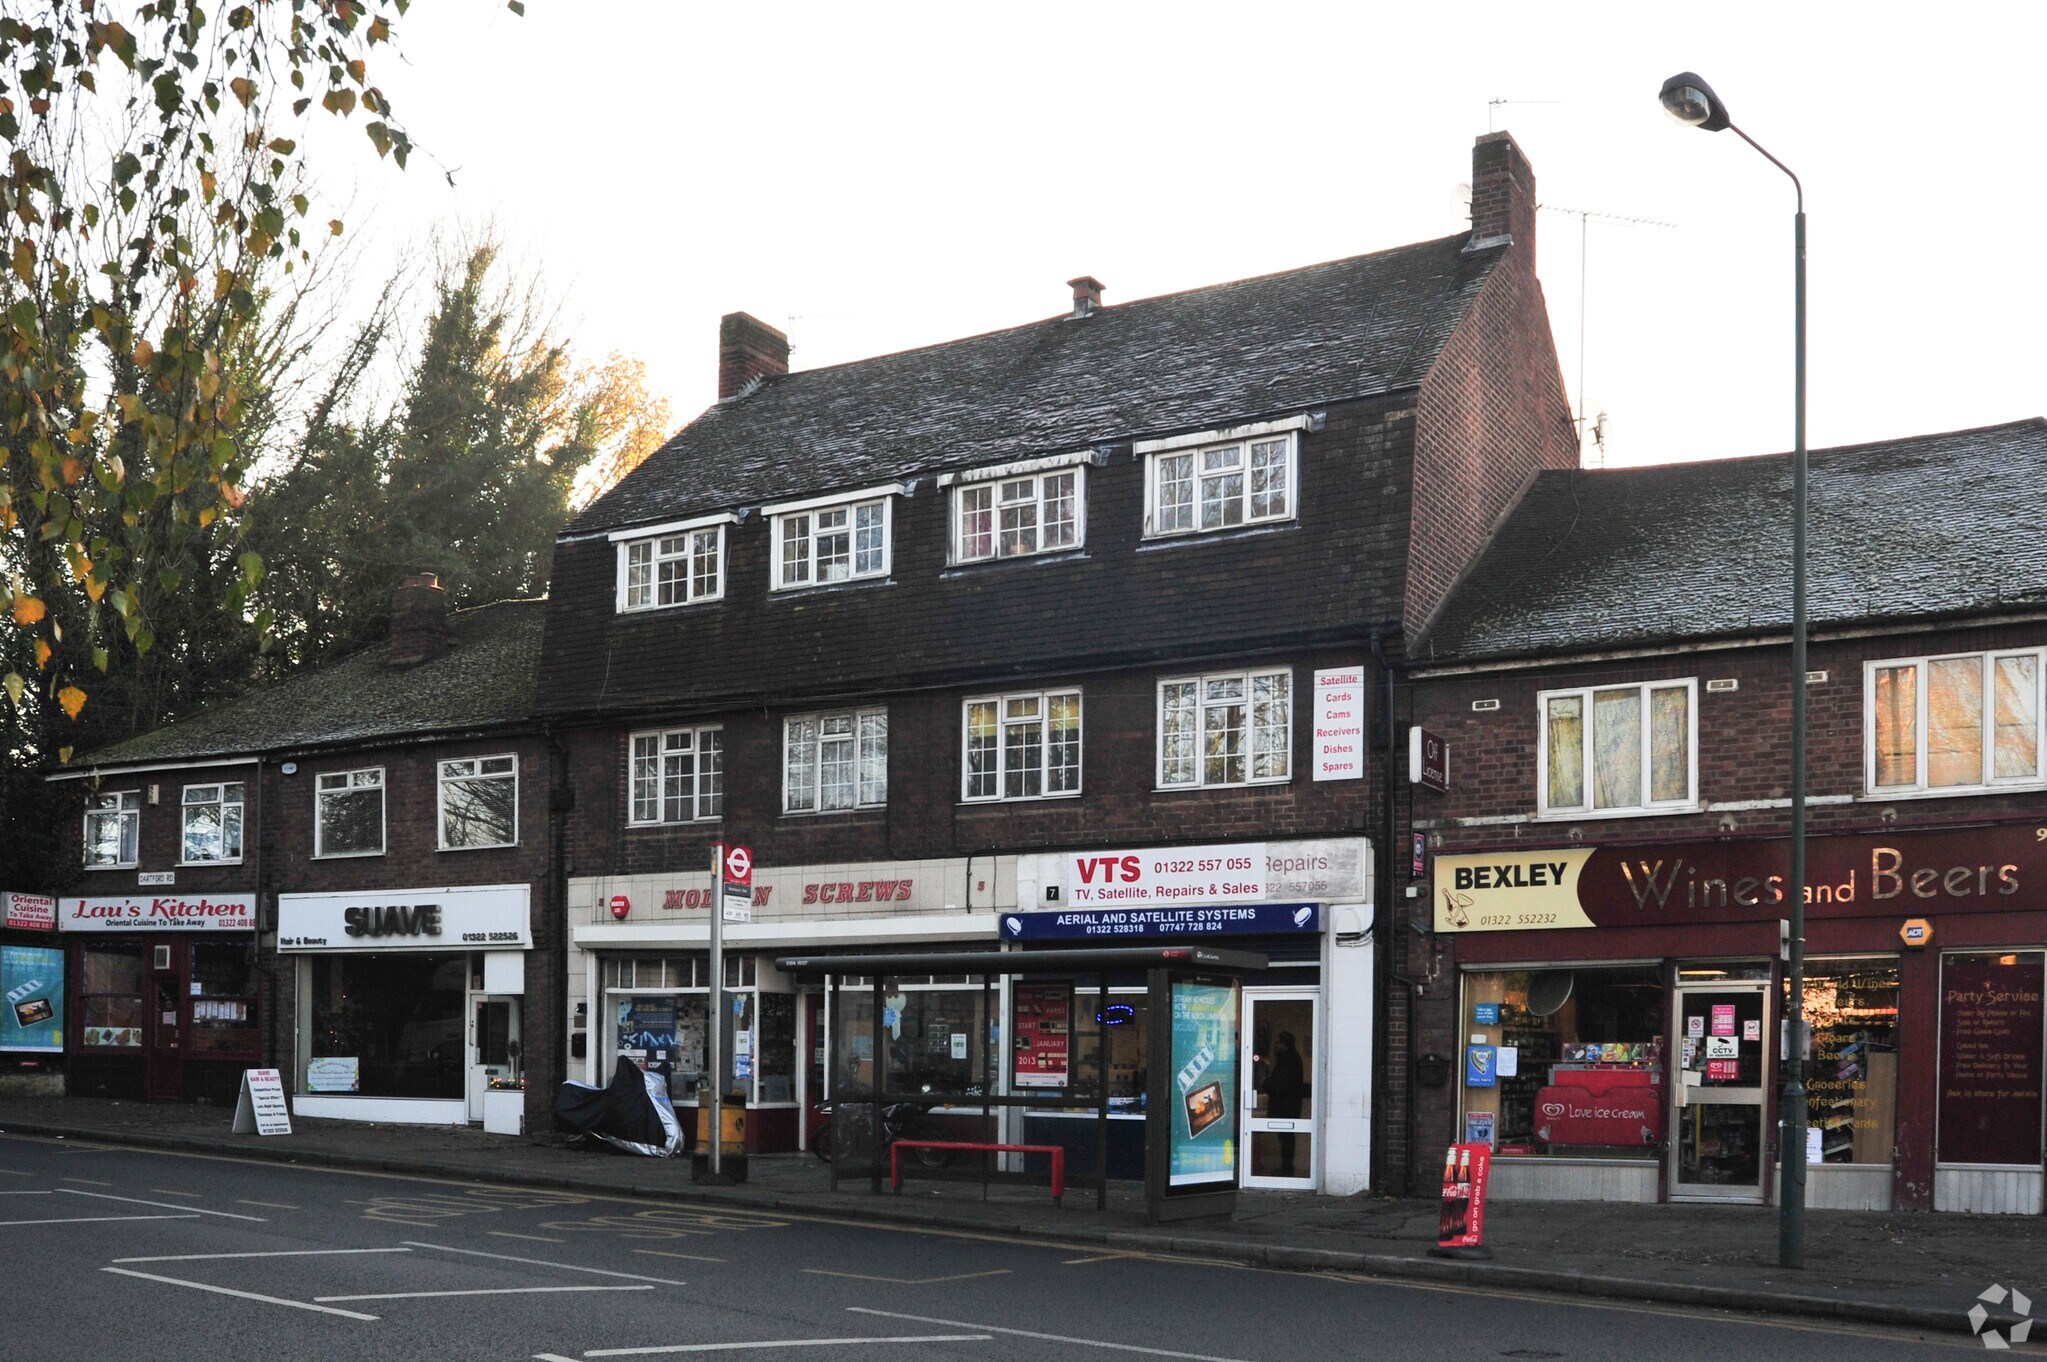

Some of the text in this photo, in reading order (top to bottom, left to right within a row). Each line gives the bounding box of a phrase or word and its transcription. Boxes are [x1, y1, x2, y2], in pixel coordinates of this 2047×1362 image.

[1320, 675, 1358, 686] Satellite
[1326, 692, 1352, 702] Cards
[1326, 711, 1351, 720] Cams
[1316, 727, 1361, 737] Receivers
[1323, 745, 1353, 754] Dishes
[1427, 740, 1438, 761] Off
[1322, 762, 1353, 773] Spares
[1077, 856, 1251, 883] VTS 01322 557 055
[1455, 862, 1568, 890] BEXLEY
[1620, 847, 2018, 910] Wines and Beers
[803, 879, 913, 905] SCREWS
[1075, 882, 1259, 901] TV, Satellite, Repairs & Sales
[1289, 881, 1328, 892] 557055
[1049, 888, 1056, 898] 7
[11, 894, 52, 906] Oriental
[14, 903, 48, 914] Cuisine
[72, 899, 247, 919] Lau's Kitchen
[344, 905, 442, 938] SUAVE
[1057, 909, 1256, 925] AERIAL AND SATELLITE SYSTEMS
[1481, 913, 1557, 925] 01322 552232
[186, 919, 206, 928] Away
[218, 919, 236, 927] 01322
[1159, 921, 1222, 932] 07747 728 824
[1086, 924, 1144, 934] 01322 528318
[1906, 928, 1923, 937] ADT
[280, 937, 294, 945] Hair
[303, 937, 327, 946] Beauty
[463, 933, 486, 941] 01322
[1948, 990, 2039, 1005] Party Service
[1036, 1040, 1065, 1048] JANUARY
[1018, 1056, 1036, 1065] 2013
[1817, 1050, 1855, 1061] Beers
[1806, 1078, 1866, 1092] Groceries
[1569, 1104, 1592, 1118] Love
[1594, 1106, 1610, 1118] ice
[1473, 1207, 1479, 1218] on
[1472, 1220, 1478, 1232] go
